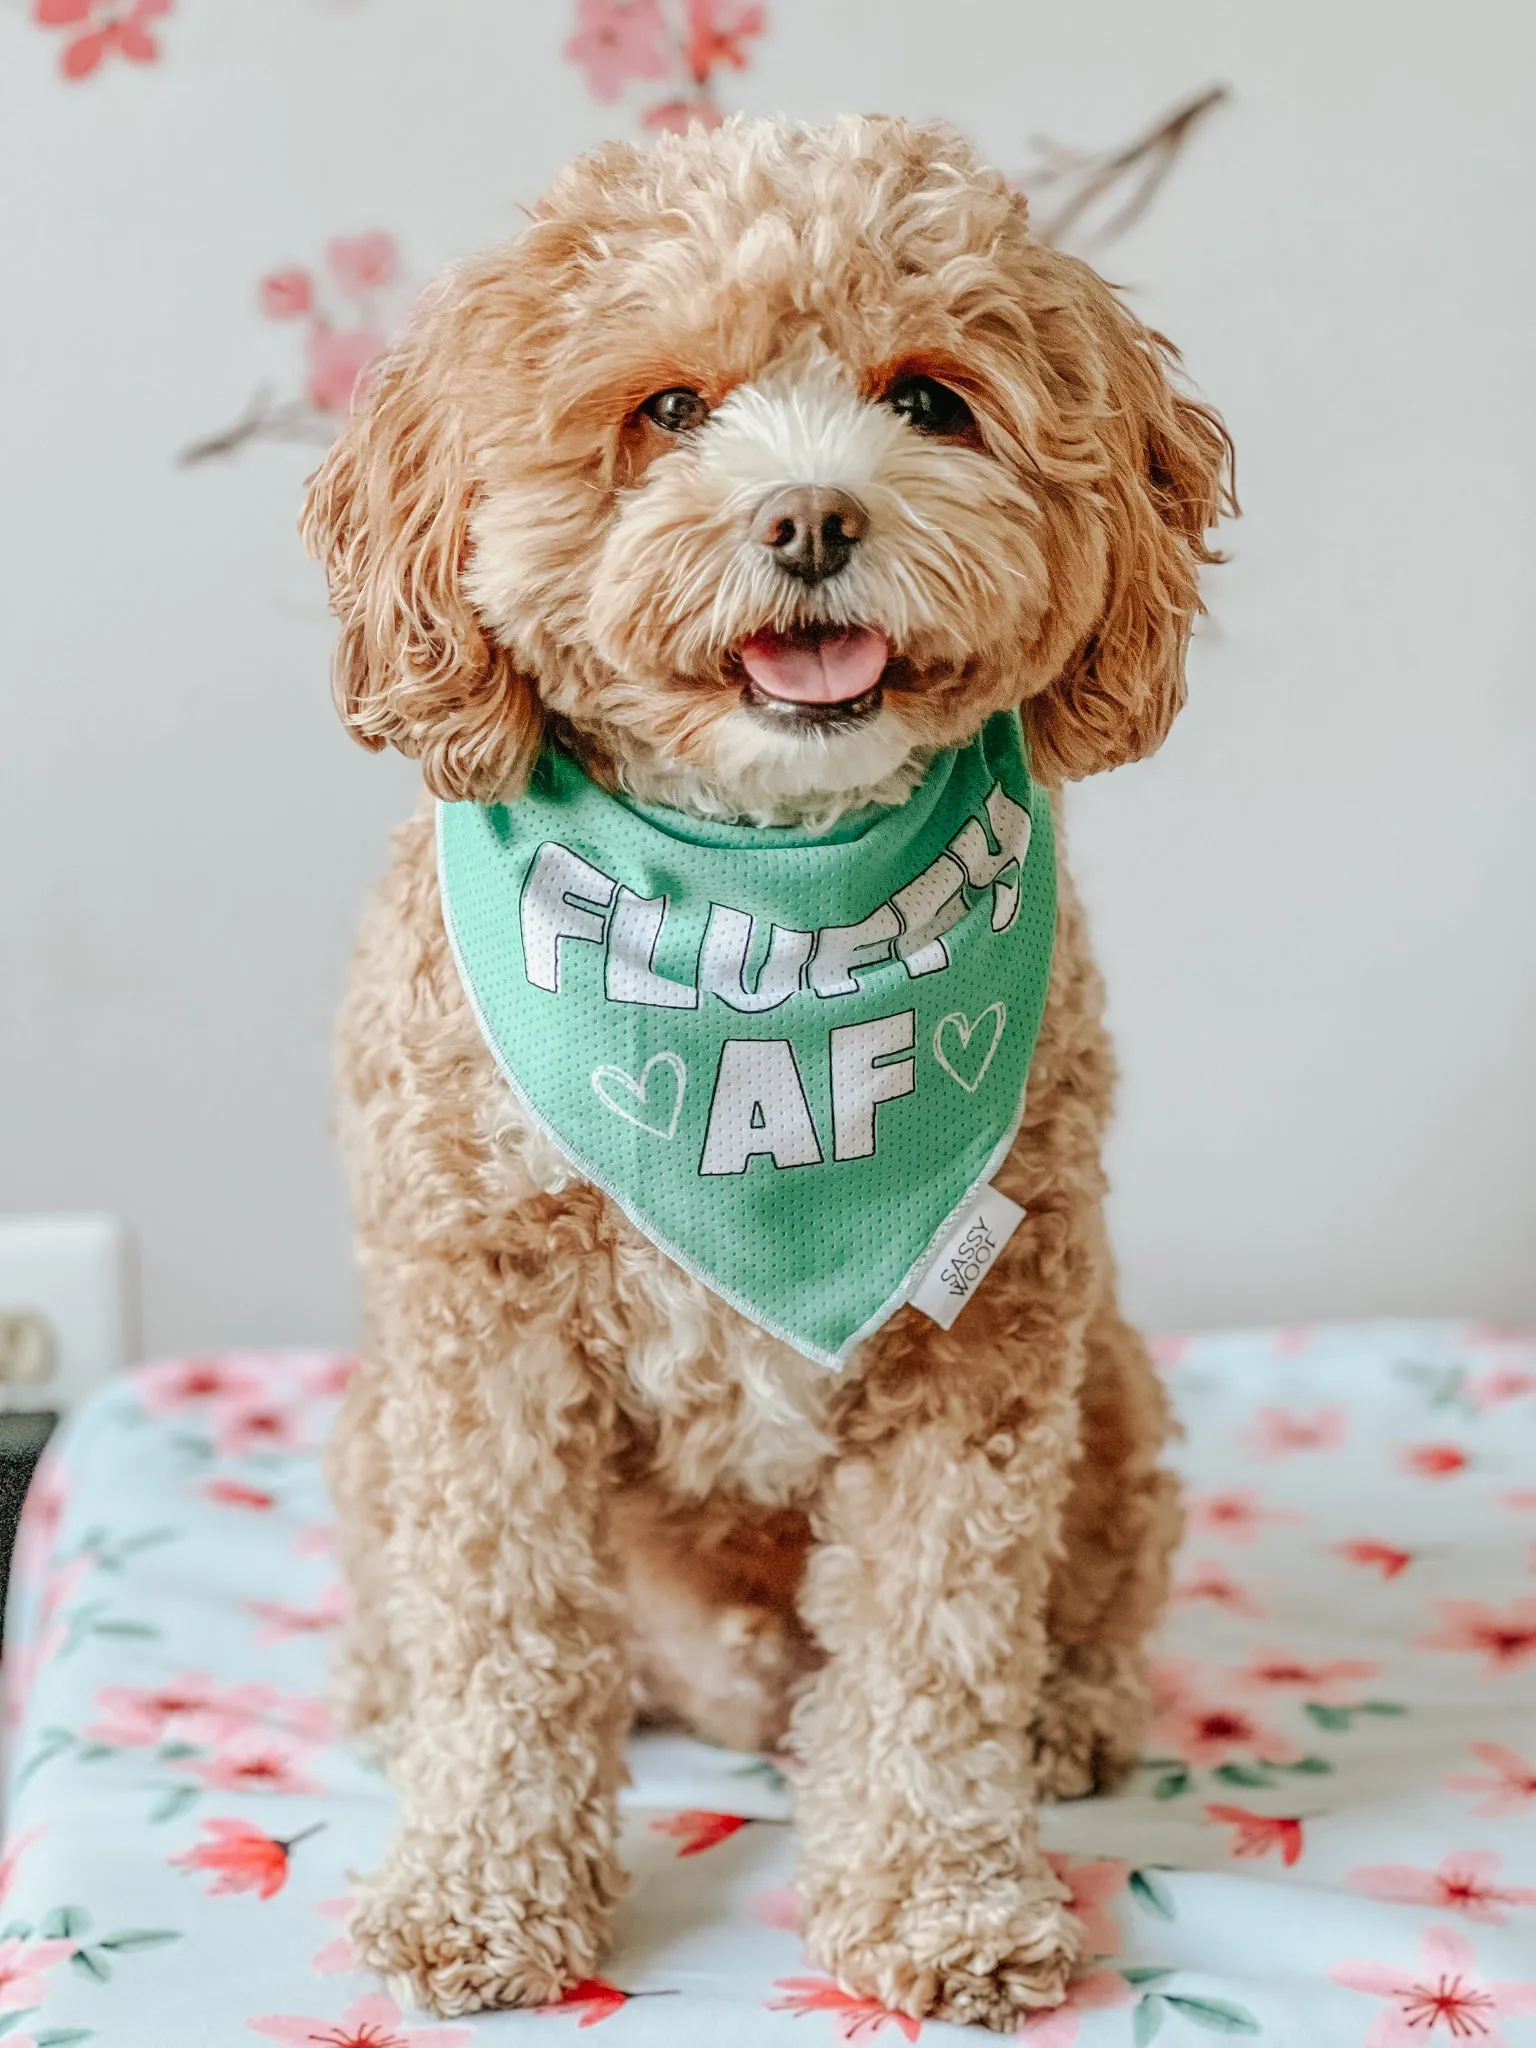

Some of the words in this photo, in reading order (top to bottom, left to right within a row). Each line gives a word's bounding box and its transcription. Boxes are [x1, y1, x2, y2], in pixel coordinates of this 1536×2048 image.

[520, 779, 1032, 1014] FLUFFY
[698, 1008, 916, 1176] AF
[941, 1216, 988, 1286] SASSY
